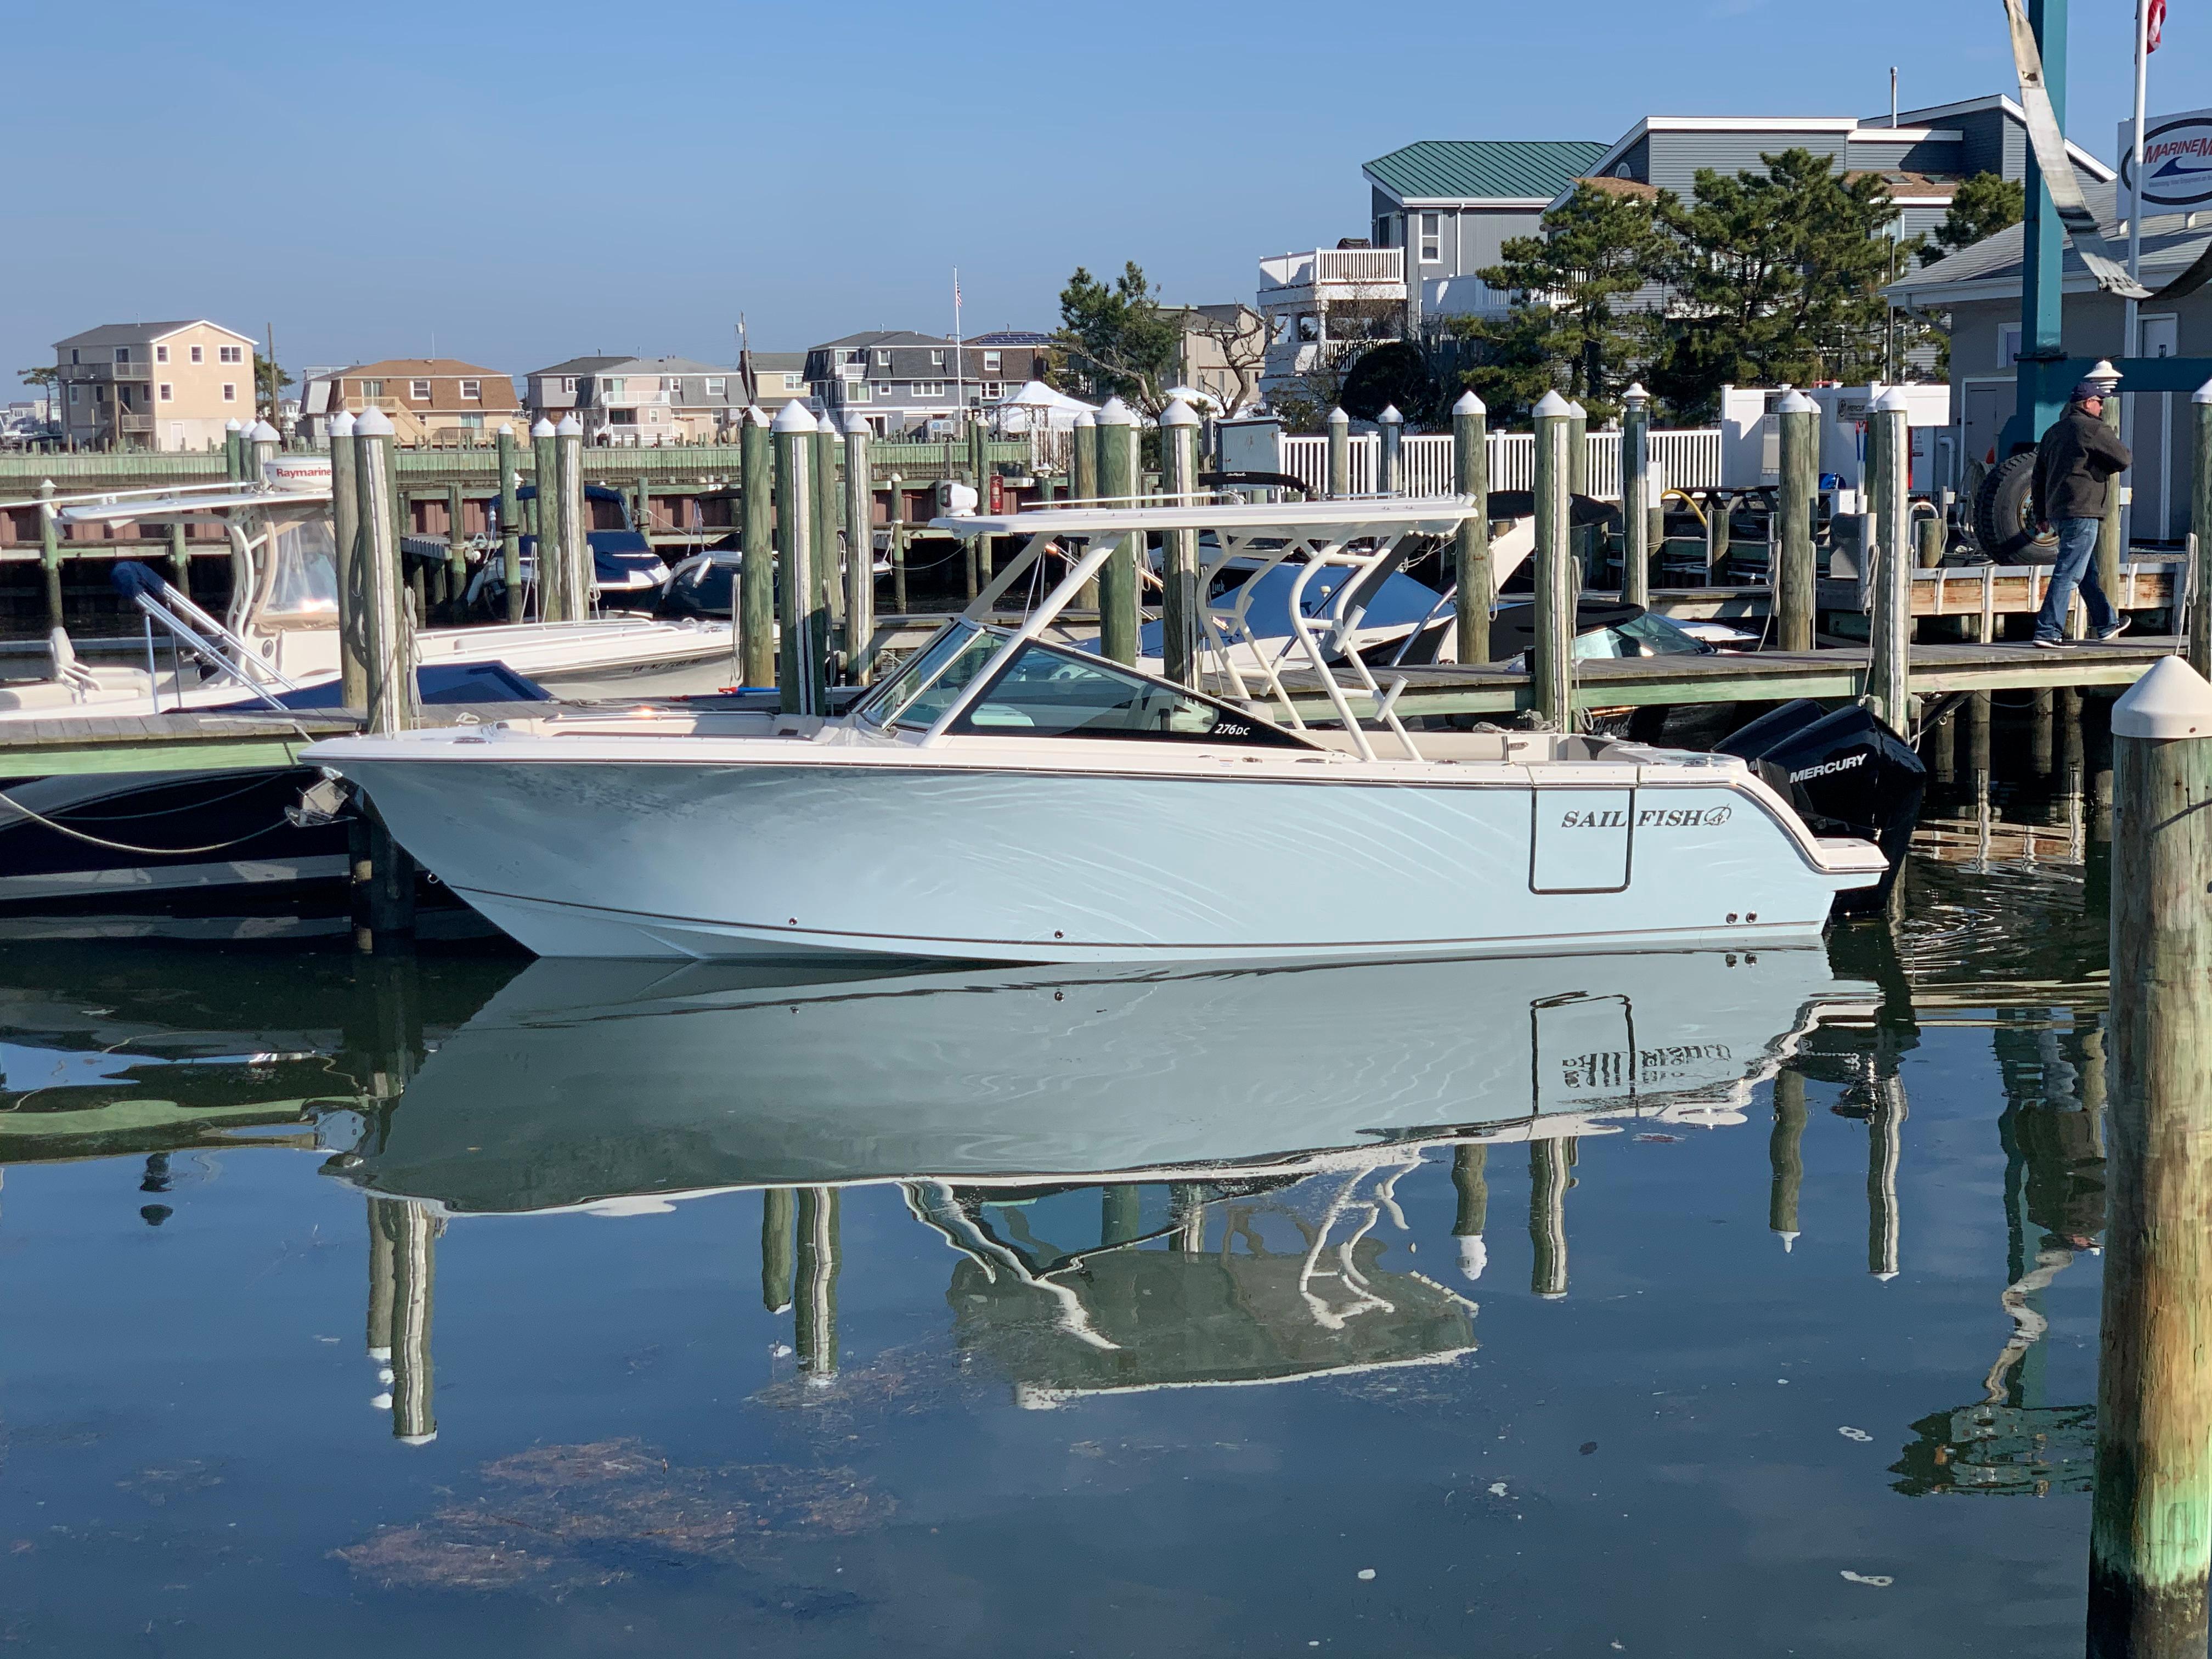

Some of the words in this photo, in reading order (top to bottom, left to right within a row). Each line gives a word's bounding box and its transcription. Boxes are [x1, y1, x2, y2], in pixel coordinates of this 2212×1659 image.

[276, 468, 332, 479] Raymarine
[1214, 724, 1250, 735] 276DC
[1790, 753, 1867, 784] MERCURY
